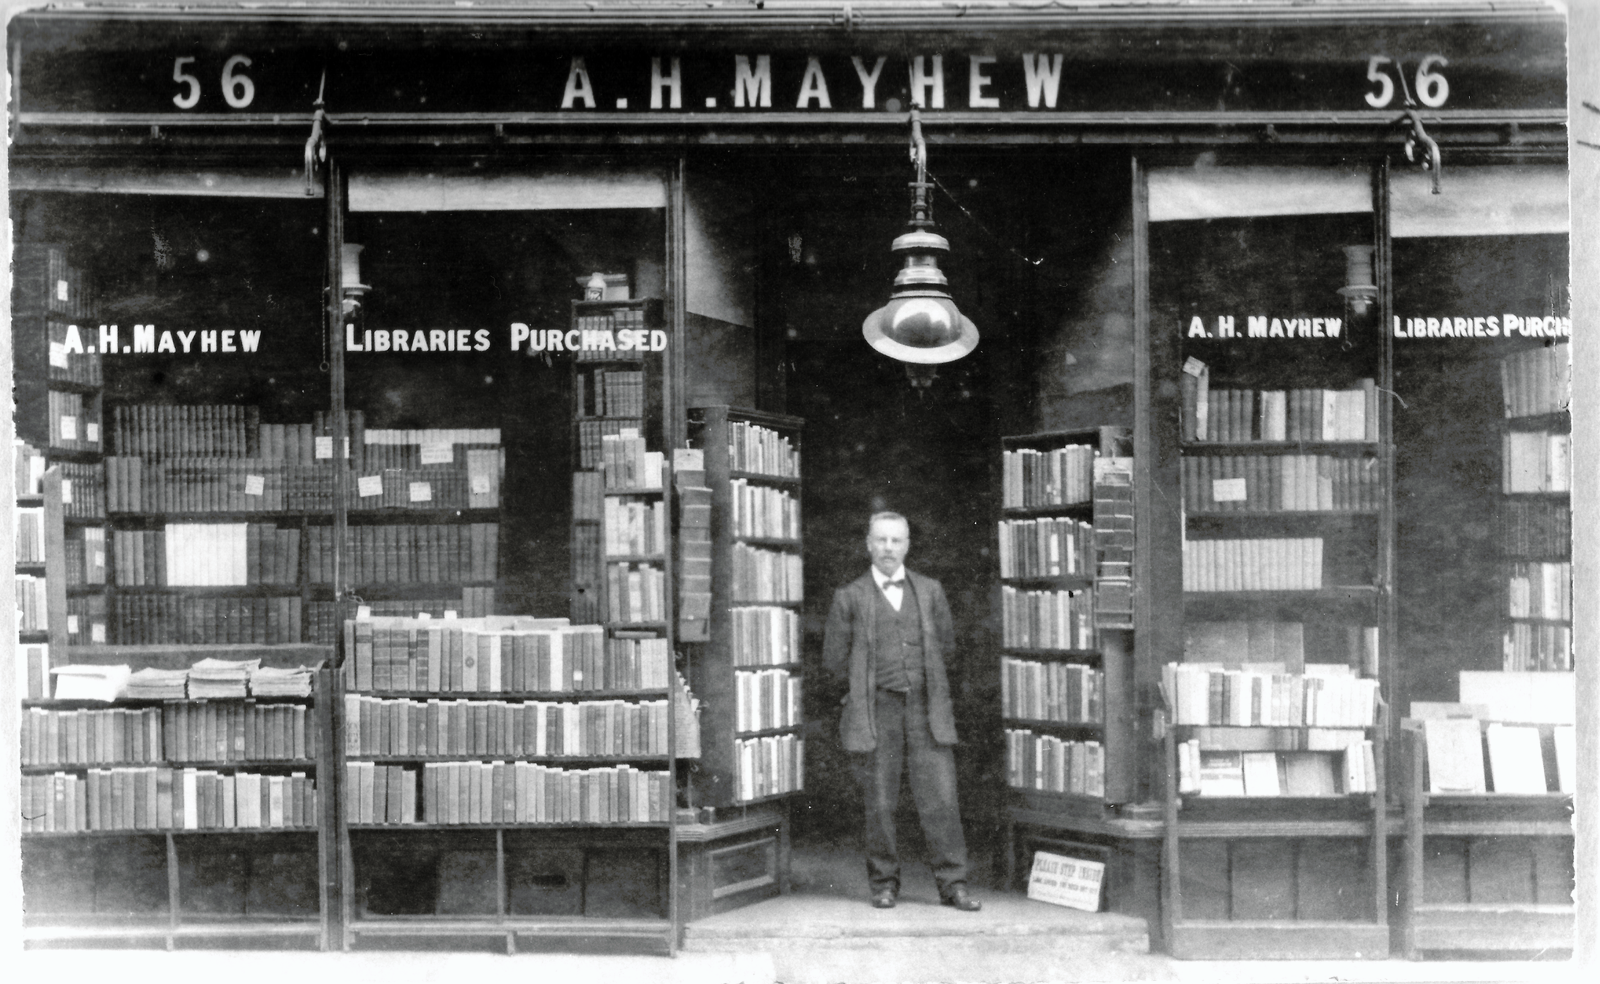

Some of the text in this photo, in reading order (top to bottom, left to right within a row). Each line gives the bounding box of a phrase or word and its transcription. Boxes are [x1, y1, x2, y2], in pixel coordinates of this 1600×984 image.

[172, 55, 256, 109] 56
[1364, 54, 1450, 109] 56
[345, 322, 668, 351] LIBRARIES PURCHASED
[1247, 315, 1343, 338] MAYHEW
[1393, 315, 1500, 338] LIBRARIES
